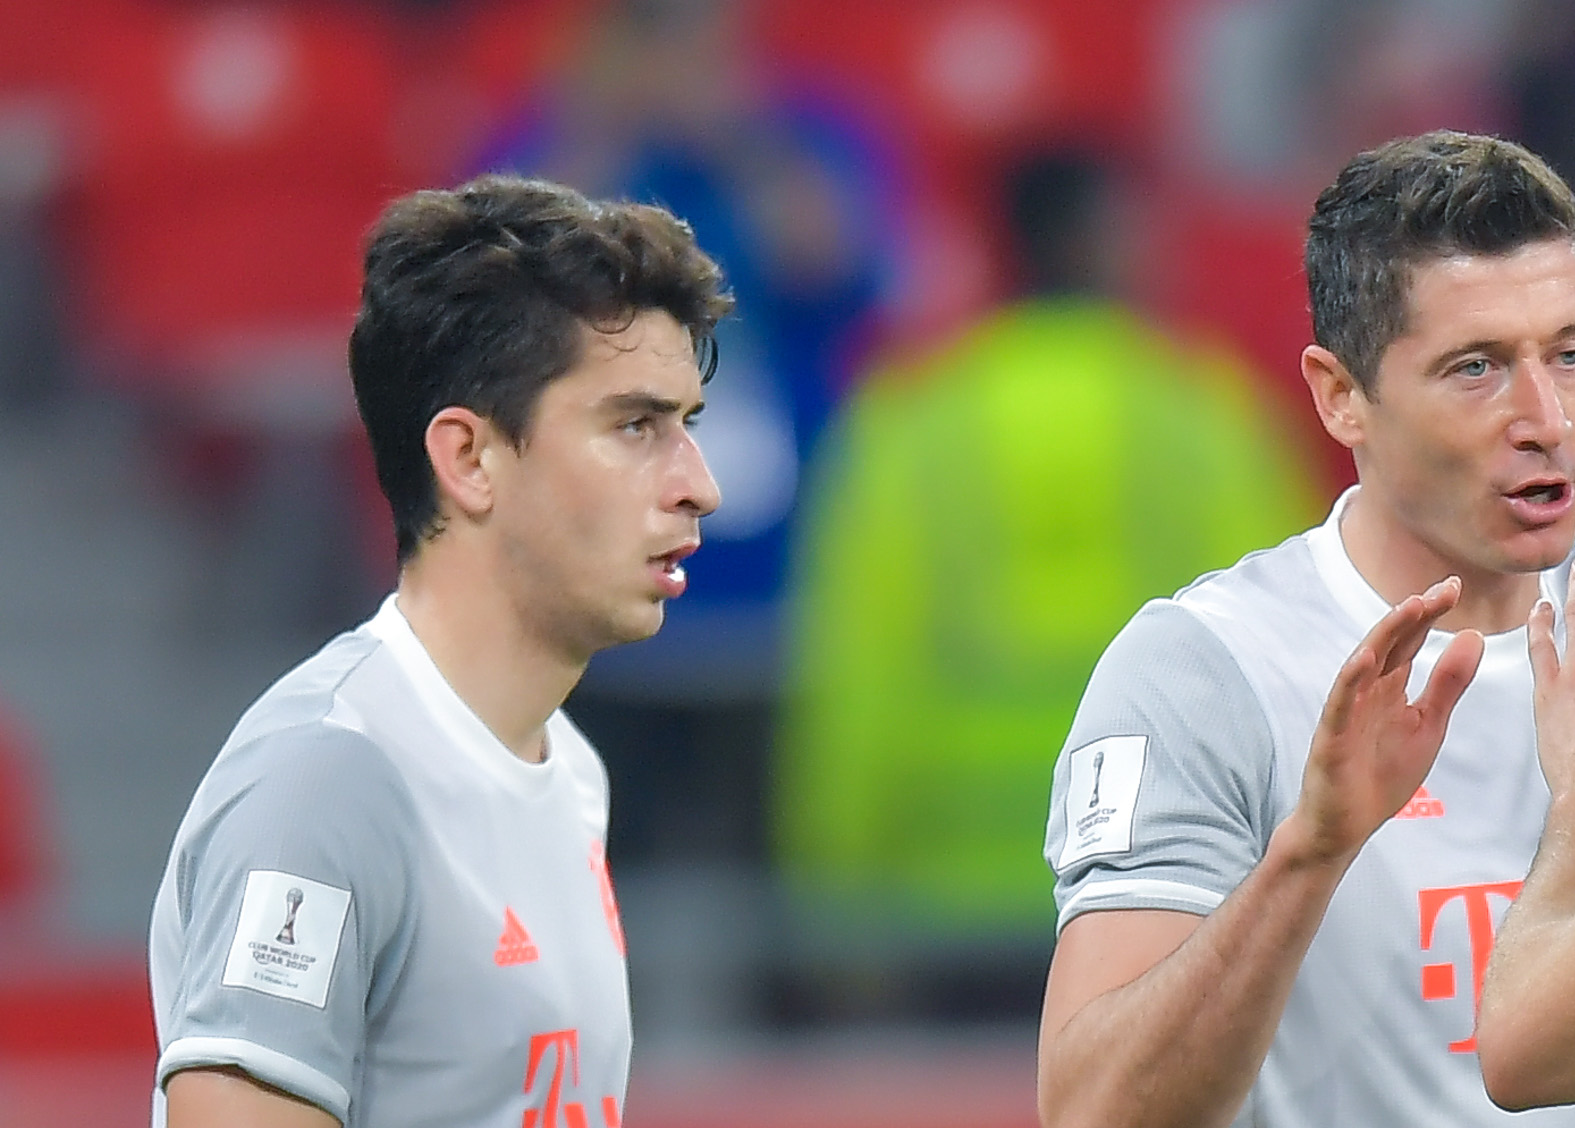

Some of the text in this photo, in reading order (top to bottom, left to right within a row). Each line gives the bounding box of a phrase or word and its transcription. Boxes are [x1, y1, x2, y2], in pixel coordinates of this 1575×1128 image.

[252, 951, 309, 971] QATAR 2020
[300, 954, 316, 963] CUP
